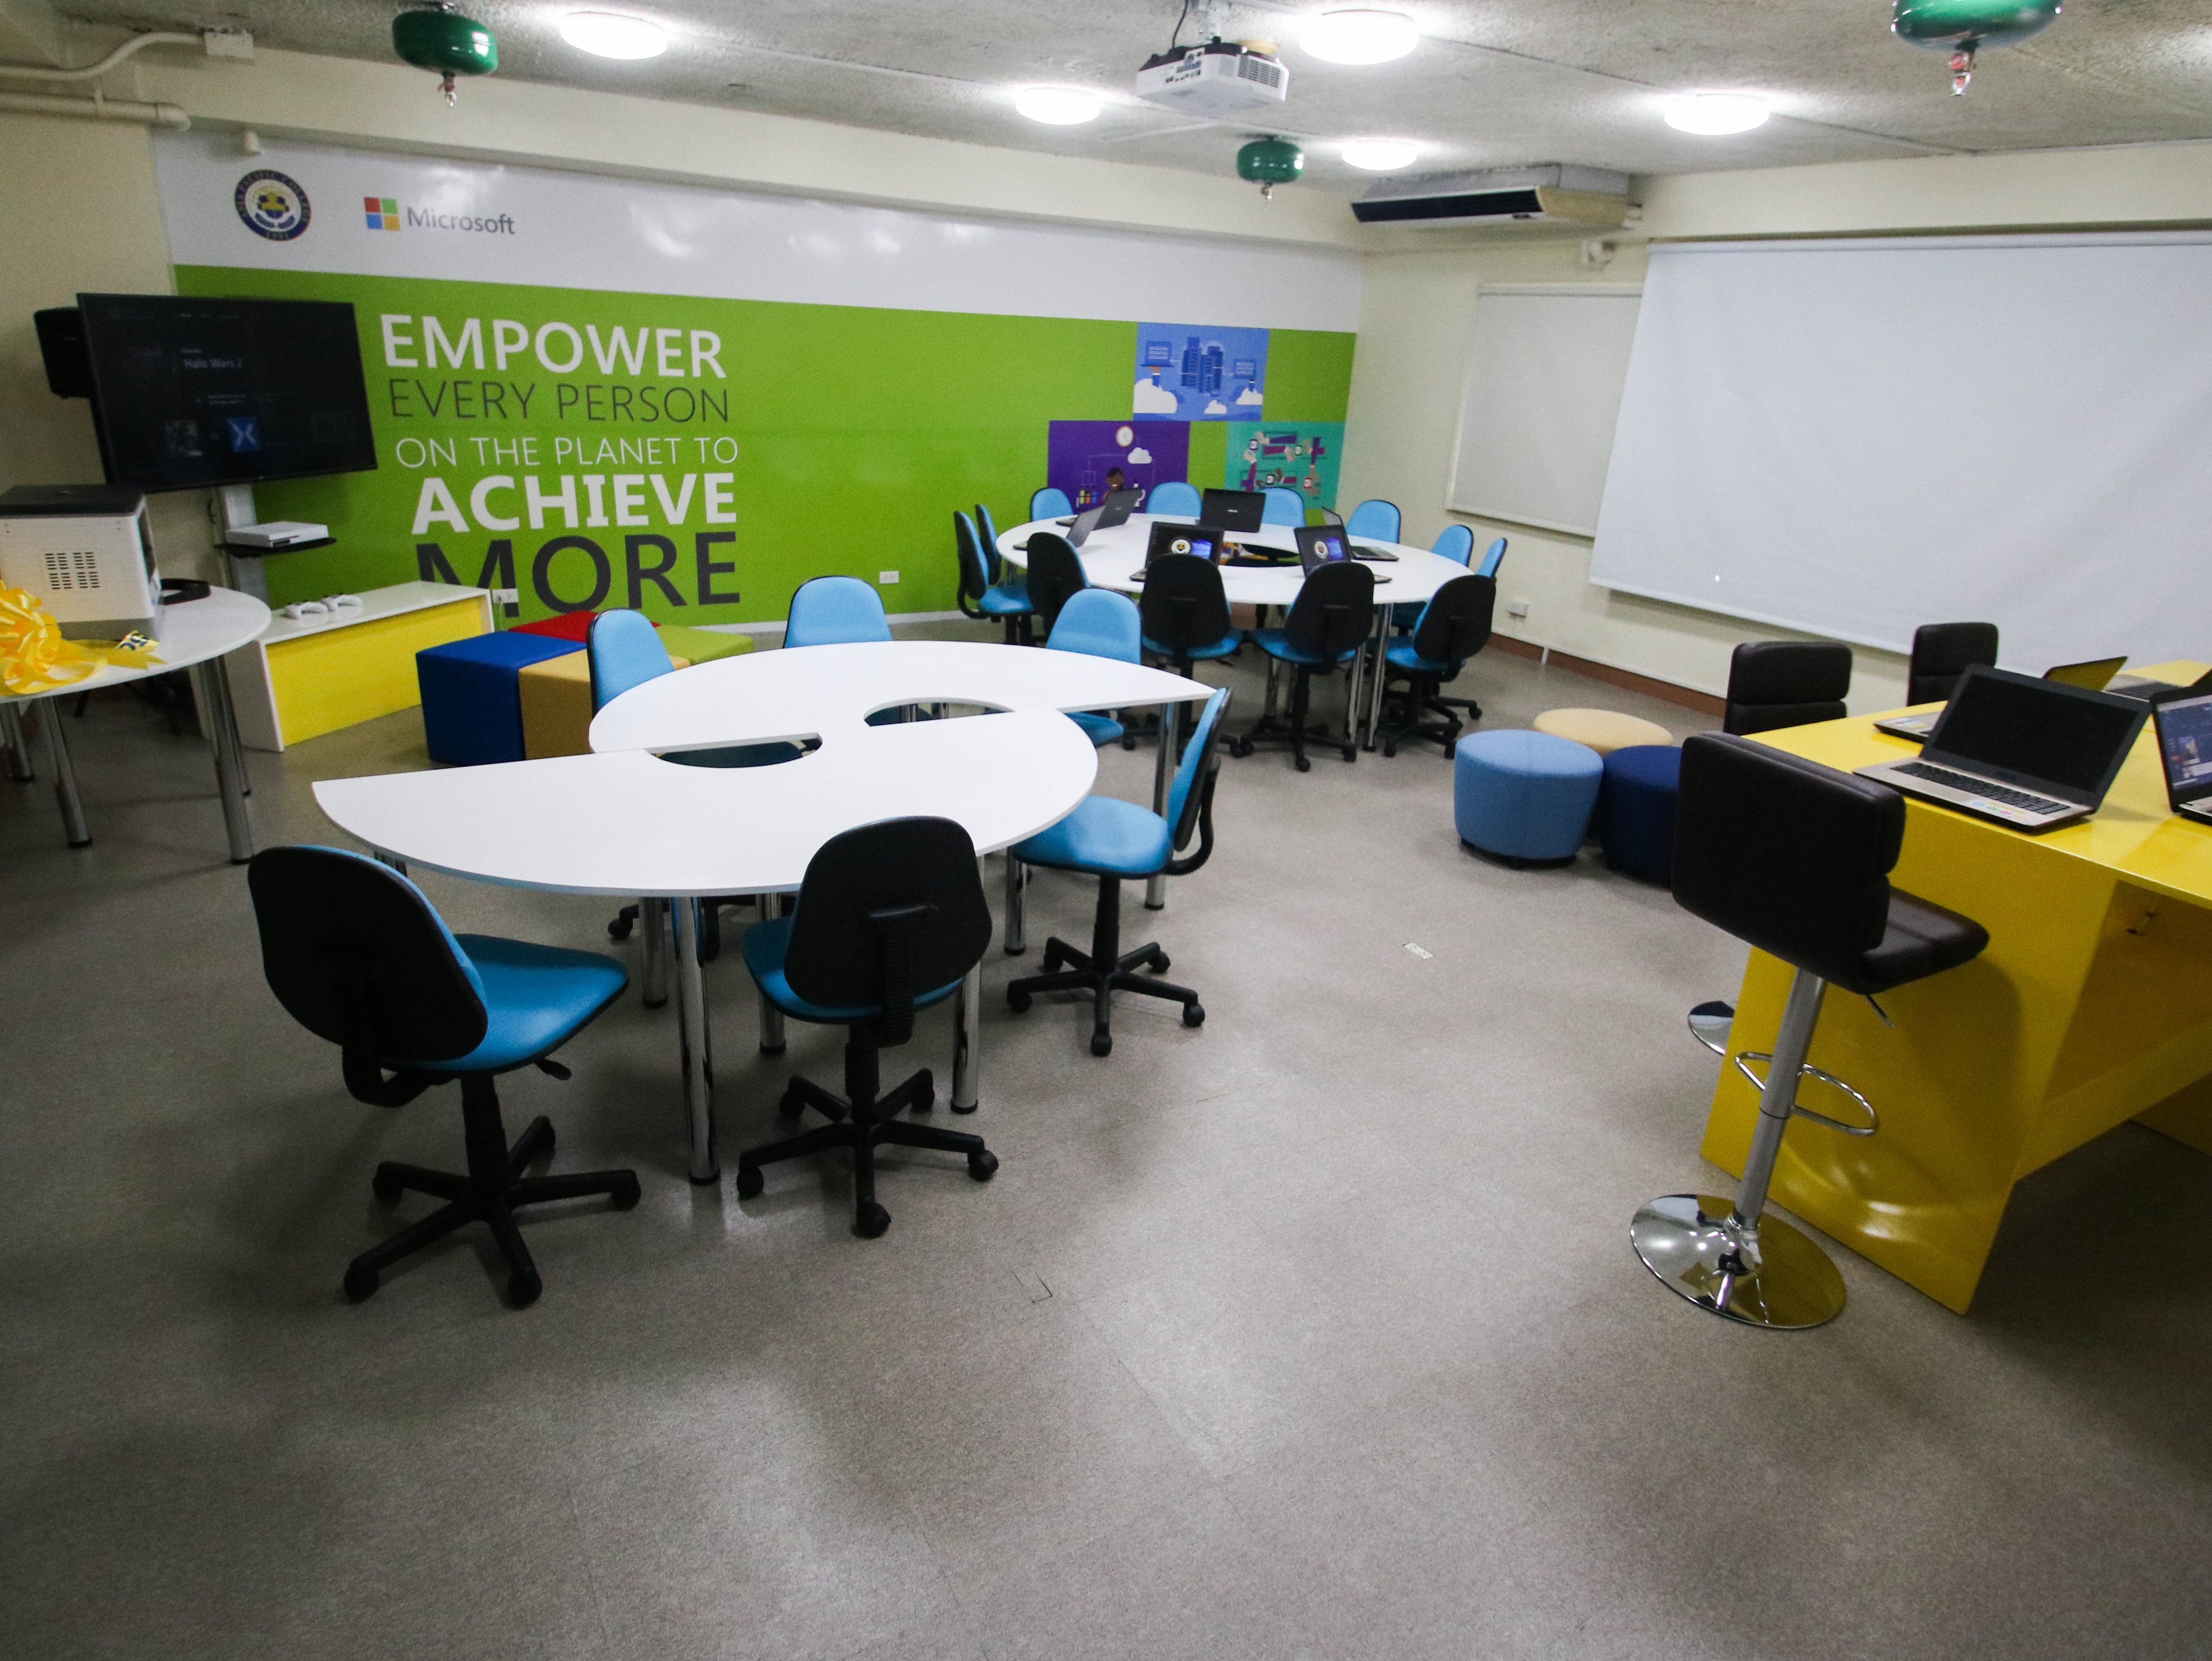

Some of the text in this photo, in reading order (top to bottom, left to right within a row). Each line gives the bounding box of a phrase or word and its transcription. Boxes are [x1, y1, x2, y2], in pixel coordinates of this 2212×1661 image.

[407, 206, 516, 234] Microsoft
[381, 314, 726, 378] EMPOWER
[389, 378, 728, 422] EVERY PERSON
[396, 437, 738, 468] ON THE PLANET TO
[411, 472, 737, 535] ACHIEVE
[415, 531, 740, 617] MORE
